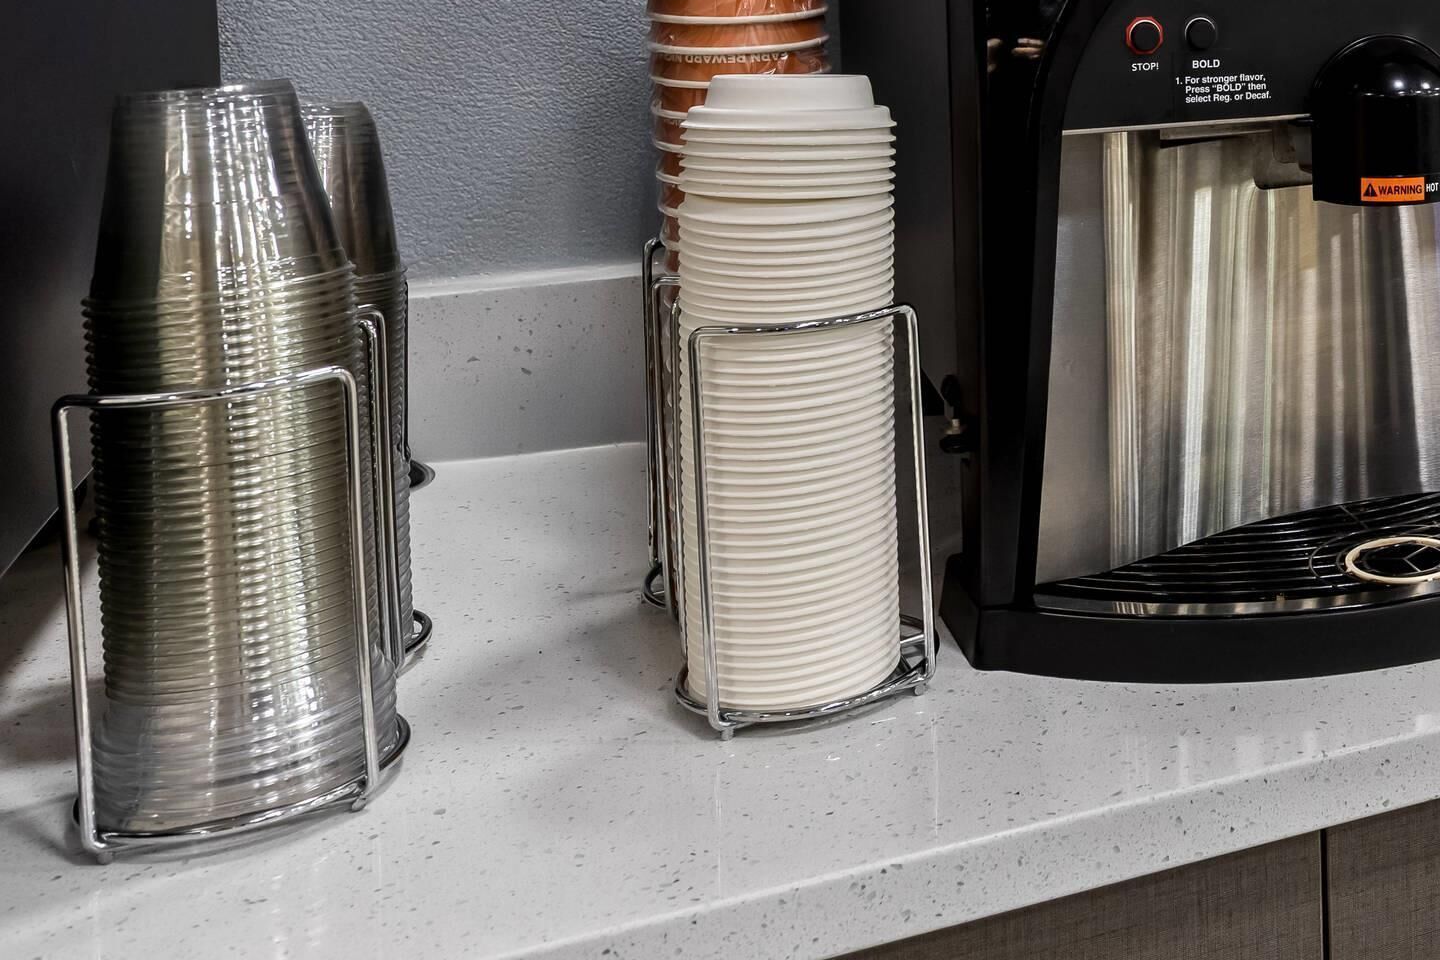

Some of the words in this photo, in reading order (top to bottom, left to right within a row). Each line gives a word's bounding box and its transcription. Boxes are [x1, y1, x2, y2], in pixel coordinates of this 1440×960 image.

[685, 53, 747, 64] REWARD
[1192, 59, 1220, 69] BOLD
[1131, 62, 1159, 71] STOP!
[1176, 77, 1183, 85] 1.
[1185, 76, 1199, 84] For
[1202, 74, 1238, 84] stronger
[1239, 73, 1266, 82] flavor,
[1185, 85, 1210, 94] Press
[1212, 83, 1246, 92] "BOLD"
[1248, 82, 1267, 90] then
[1185, 94, 1211, 103] select
[1213, 93, 1232, 103] Reg.
[1245, 91, 1272, 100] Decaf.
[1378, 184, 1423, 195] WARNING
[1426, 182, 1439, 192] HOT
